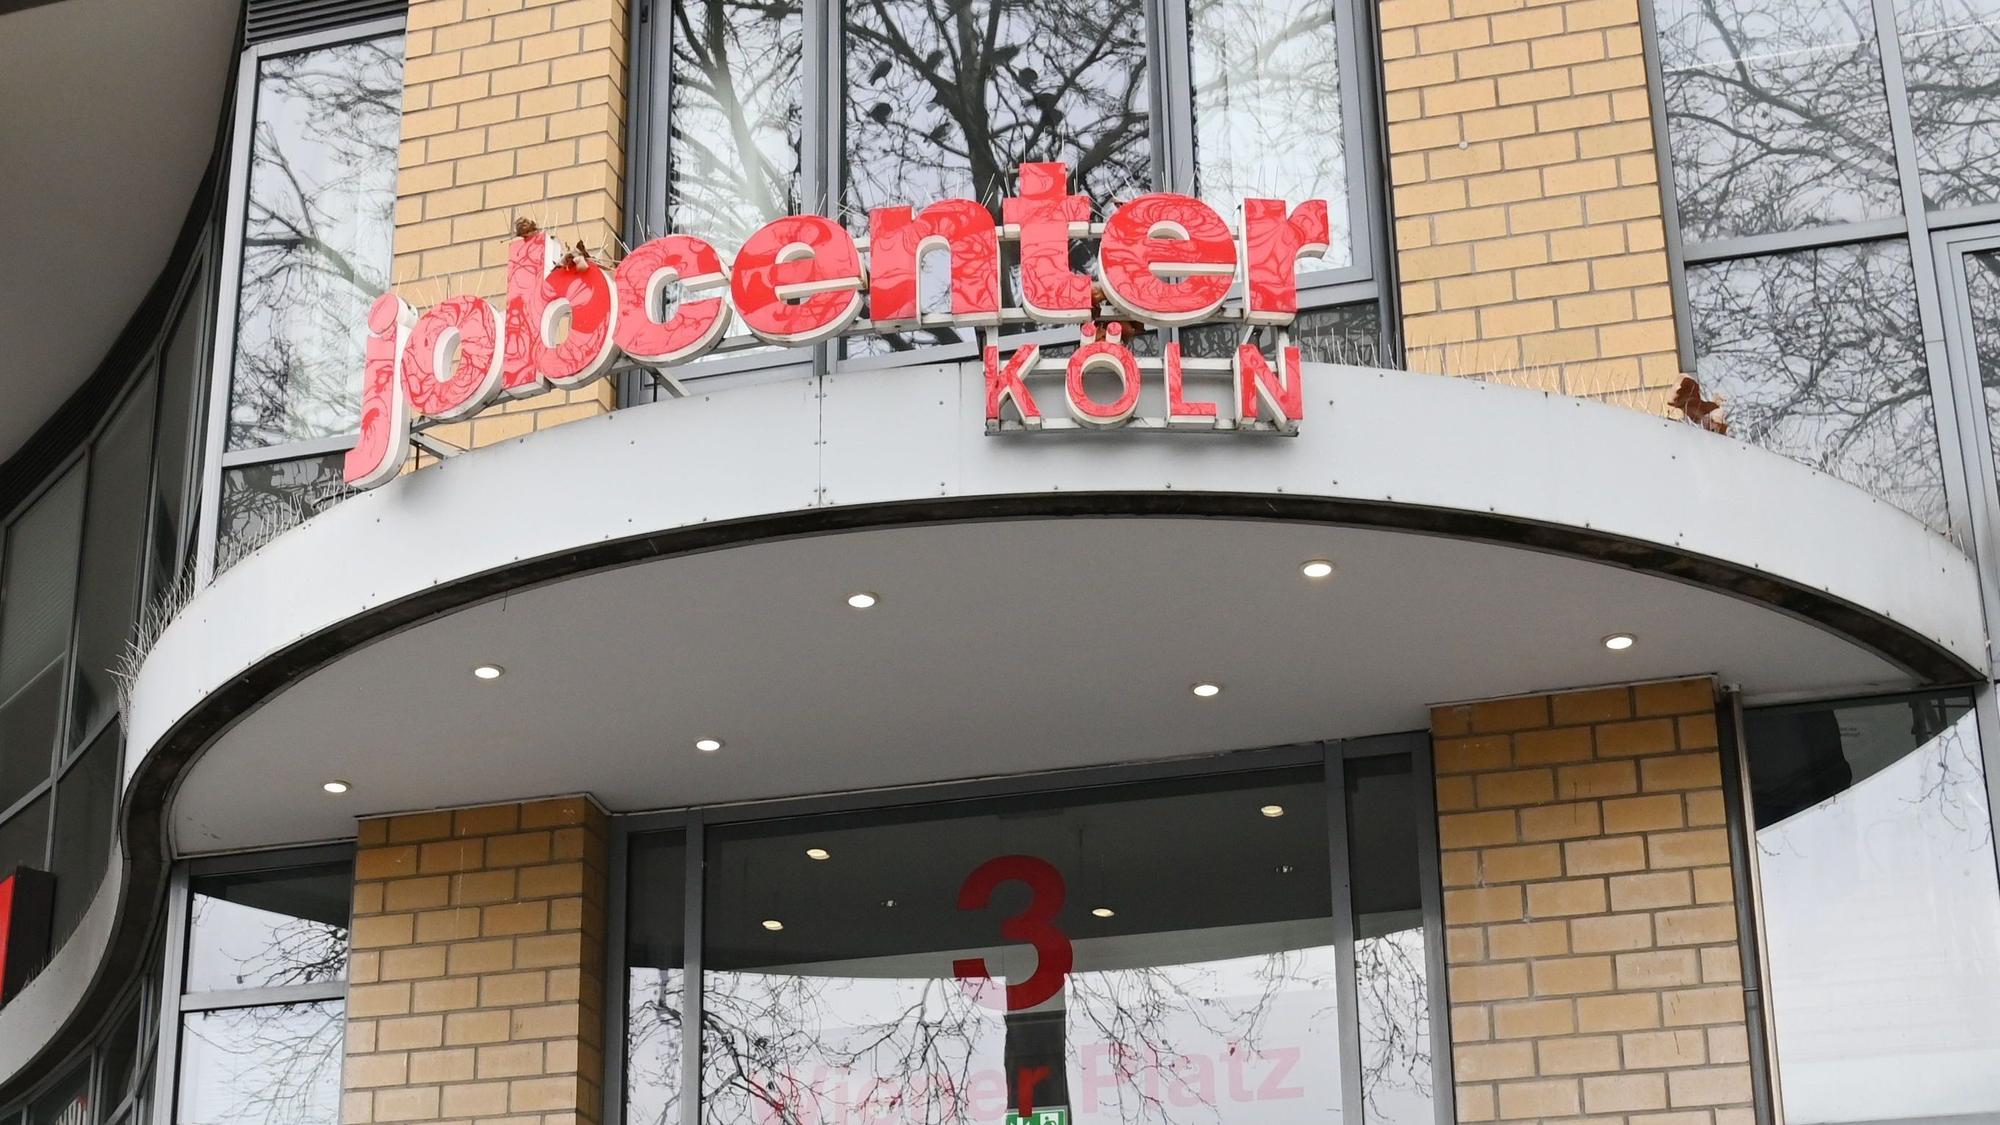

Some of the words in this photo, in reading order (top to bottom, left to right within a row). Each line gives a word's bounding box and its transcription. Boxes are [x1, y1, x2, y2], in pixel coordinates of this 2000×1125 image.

[344, 162, 1330, 490] jobcenter
[983, 321, 1304, 433] KÖLN
[952, 854, 1074, 1011] 3
[746, 1062, 1051, 1125] Wiener
[1080, 1037, 1304, 1113] Platz
